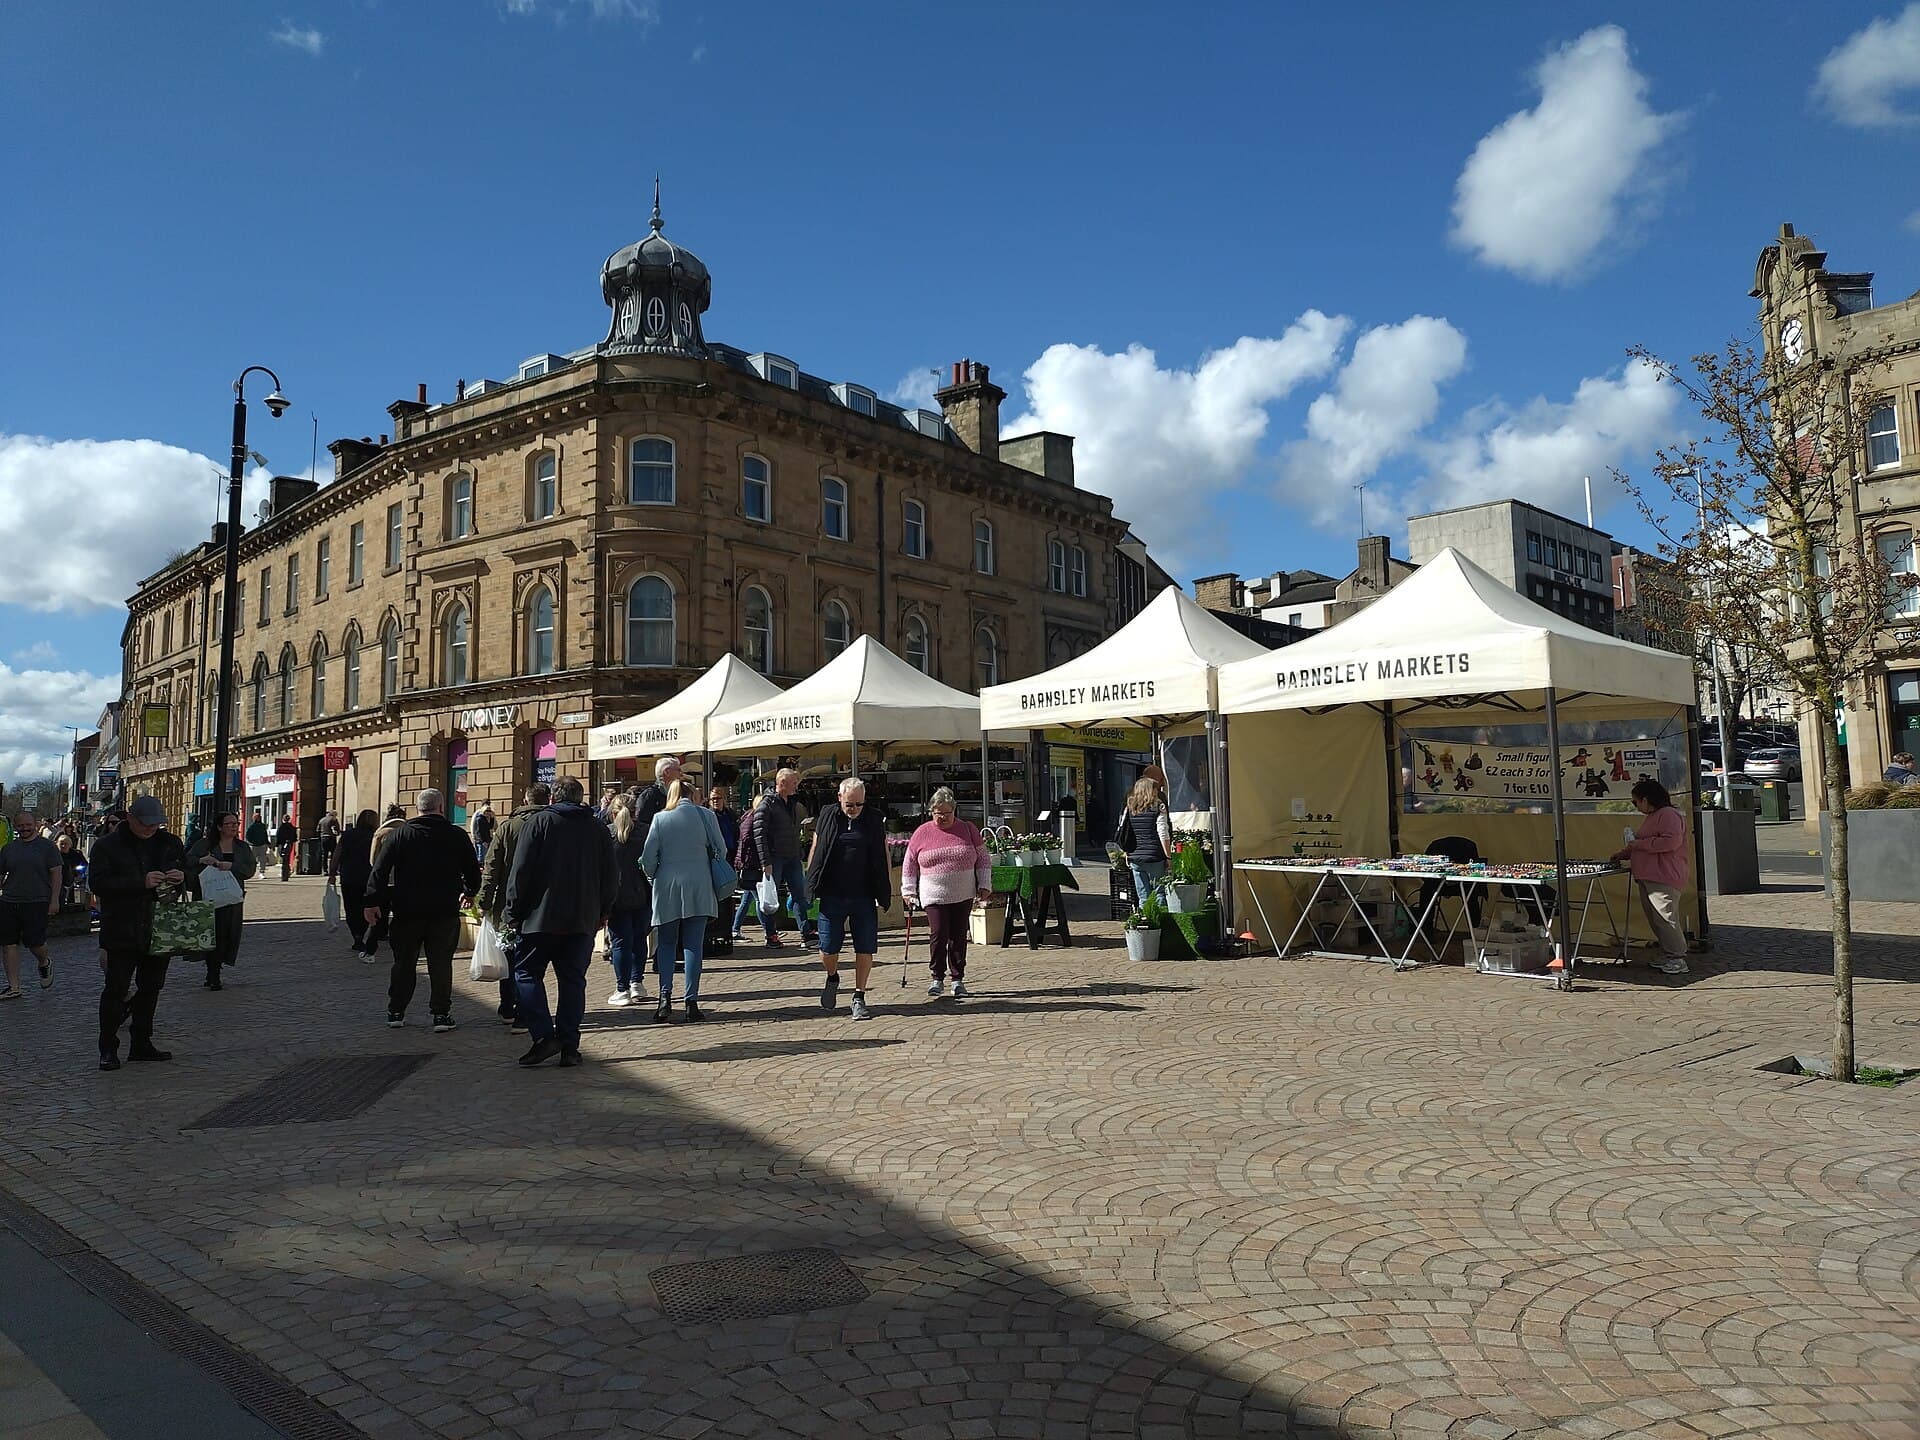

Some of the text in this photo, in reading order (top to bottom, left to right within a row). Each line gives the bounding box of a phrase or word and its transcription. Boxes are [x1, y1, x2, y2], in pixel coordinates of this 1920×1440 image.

[1276, 652, 1470, 690] BARNSLEY MARKETS
[1021, 680, 1155, 710] BARNSLEY MARKETS
[734, 714, 821, 736] BARNSLEY MARKETS
[609, 727, 678, 747] BARNSLEY MARKETS
[1073, 727, 1125, 741] honeGeeks
[1495, 752, 1550, 765] Small figur
[1485, 766, 1499, 776] £2
[1500, 767, 1524, 777] each
[1526, 767, 1534, 777] 3
[1535, 767, 1551, 777] for
[1503, 783, 1550, 794] 7 for £10
